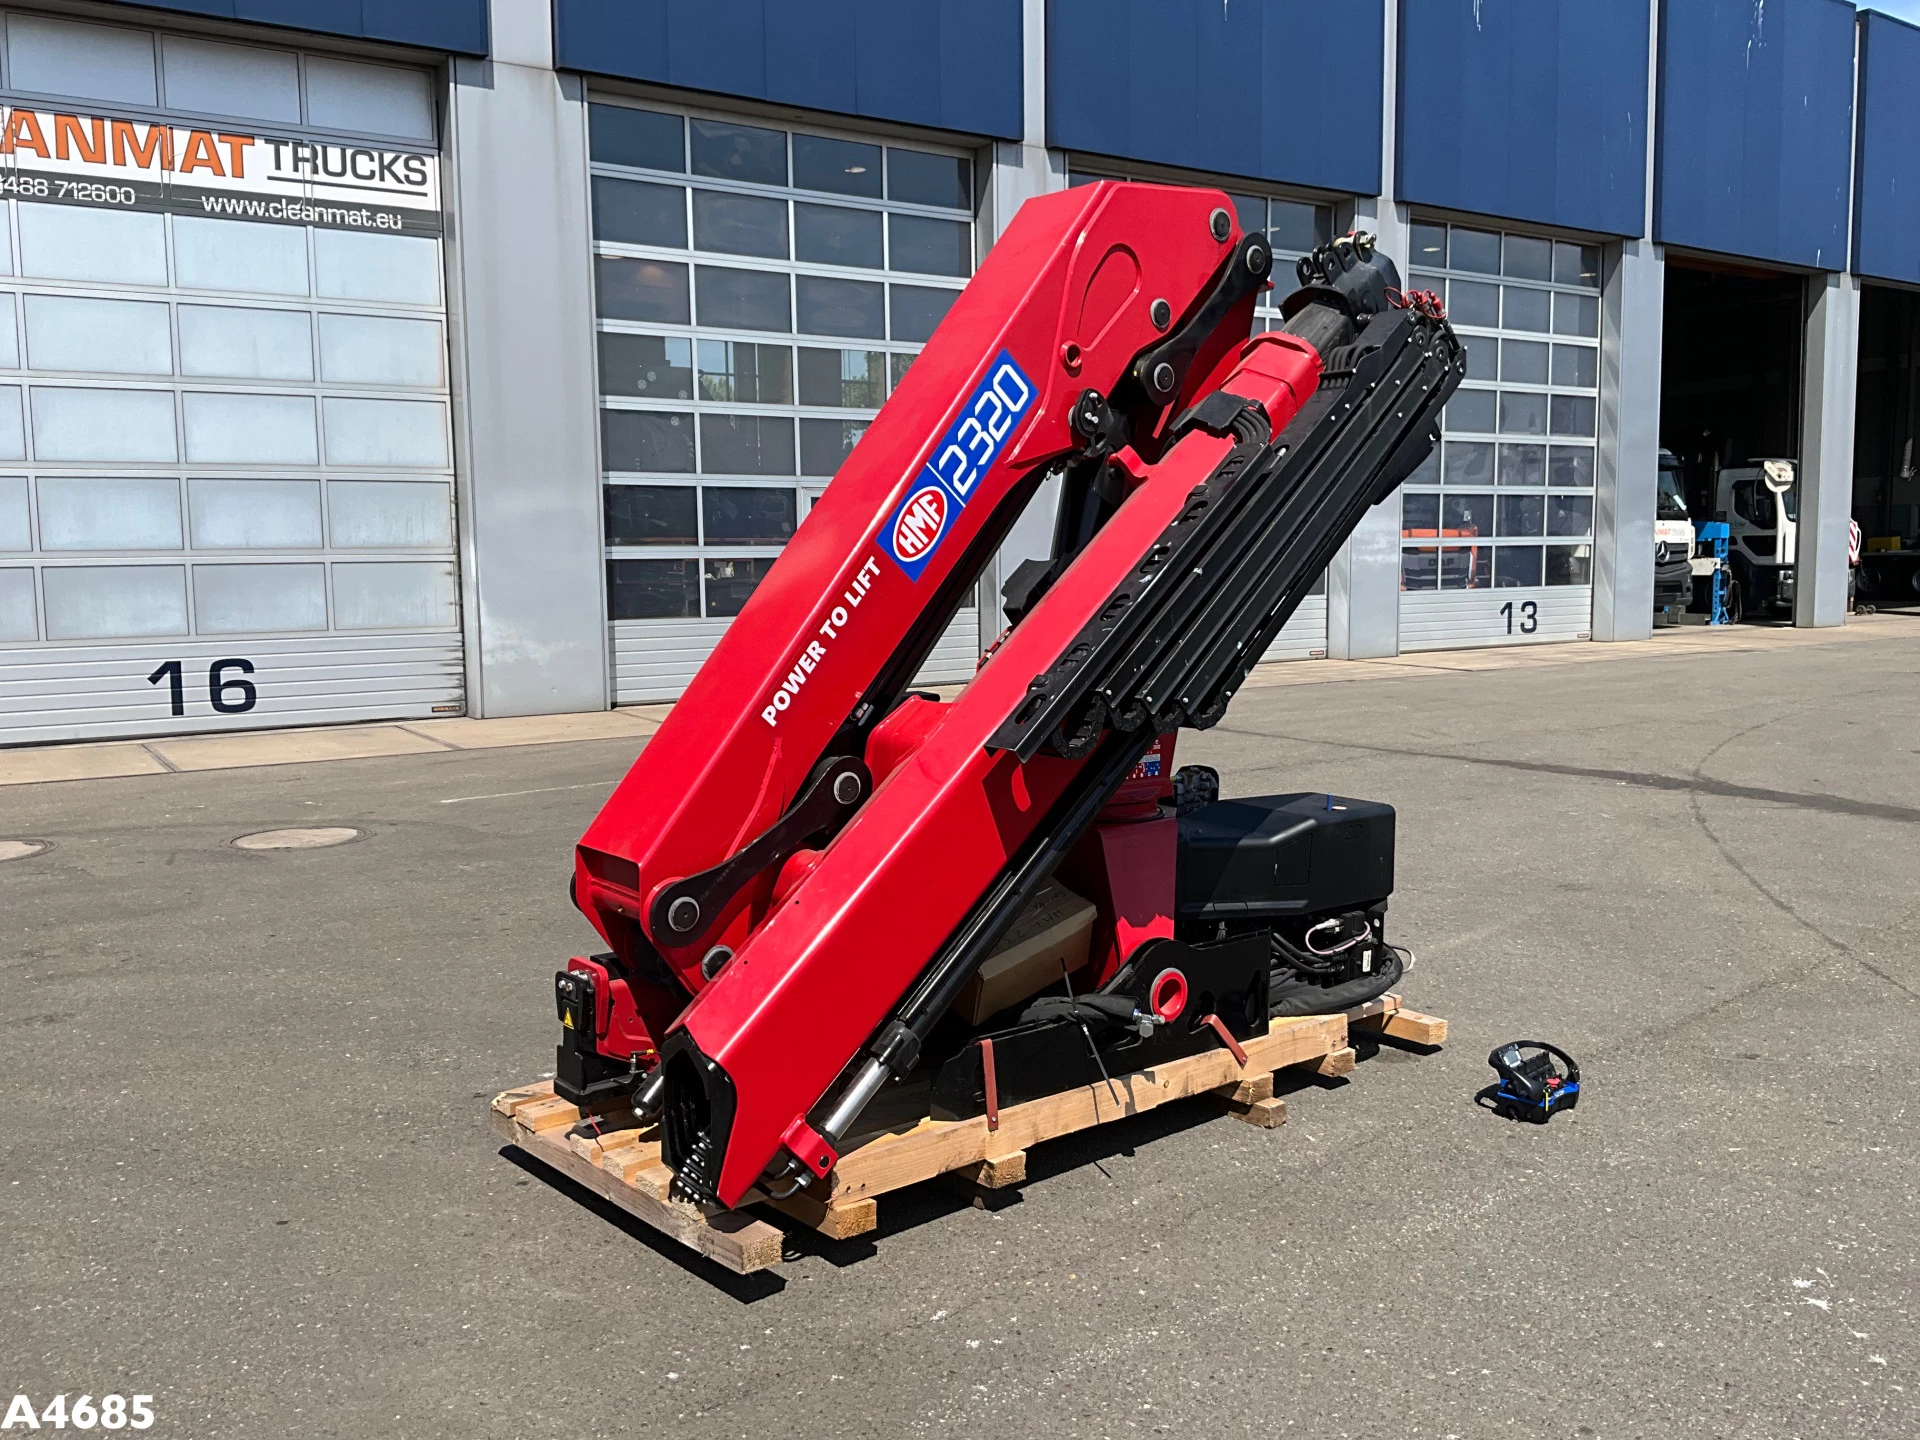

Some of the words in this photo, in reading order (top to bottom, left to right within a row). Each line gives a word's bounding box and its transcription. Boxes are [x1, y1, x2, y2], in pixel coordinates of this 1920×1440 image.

[264, 138, 428, 186] TRUCKS
[54, 180, 136, 205] 712600
[201, 195, 402, 230] www.cleanmat.eu
[898, 494, 941, 555] HMF
[939, 364, 1029, 496] 2320
[761, 640, 827, 727] POWER
[819, 606, 848, 639] TO
[844, 555, 881, 608] LIFT
[1500, 601, 1538, 635] 13
[147, 658, 256, 716] 16
